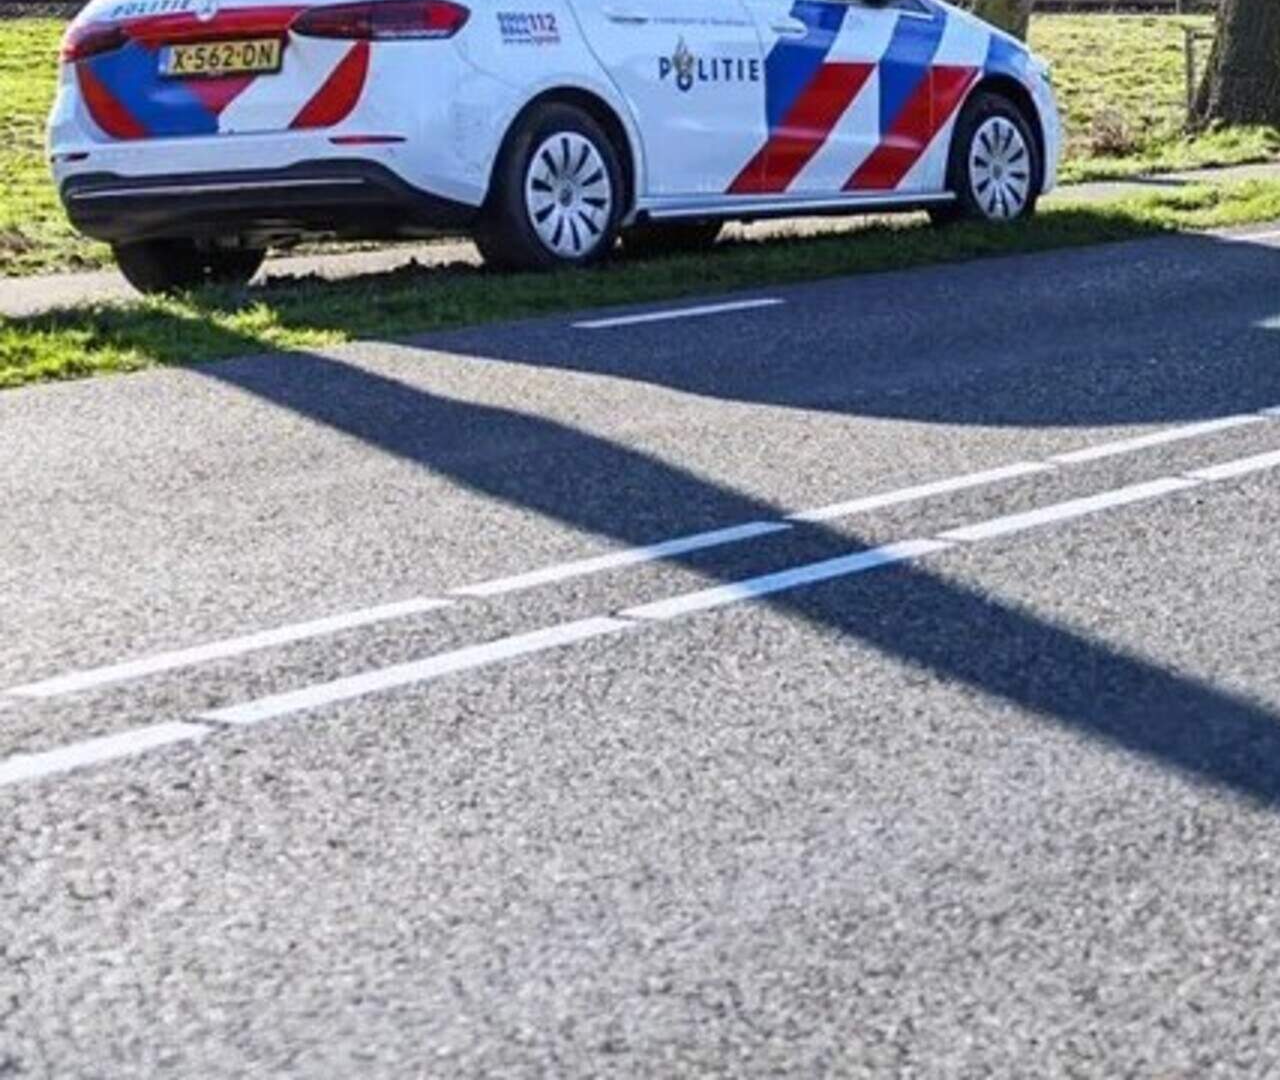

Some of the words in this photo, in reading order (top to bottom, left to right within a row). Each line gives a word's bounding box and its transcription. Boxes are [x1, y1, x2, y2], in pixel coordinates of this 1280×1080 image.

[112, 0, 191, 18] POLITIE
[528, 13, 557, 31] 112
[173, 44, 274, 70] X-562-DN
[659, 56, 759, 92] POLITIE
